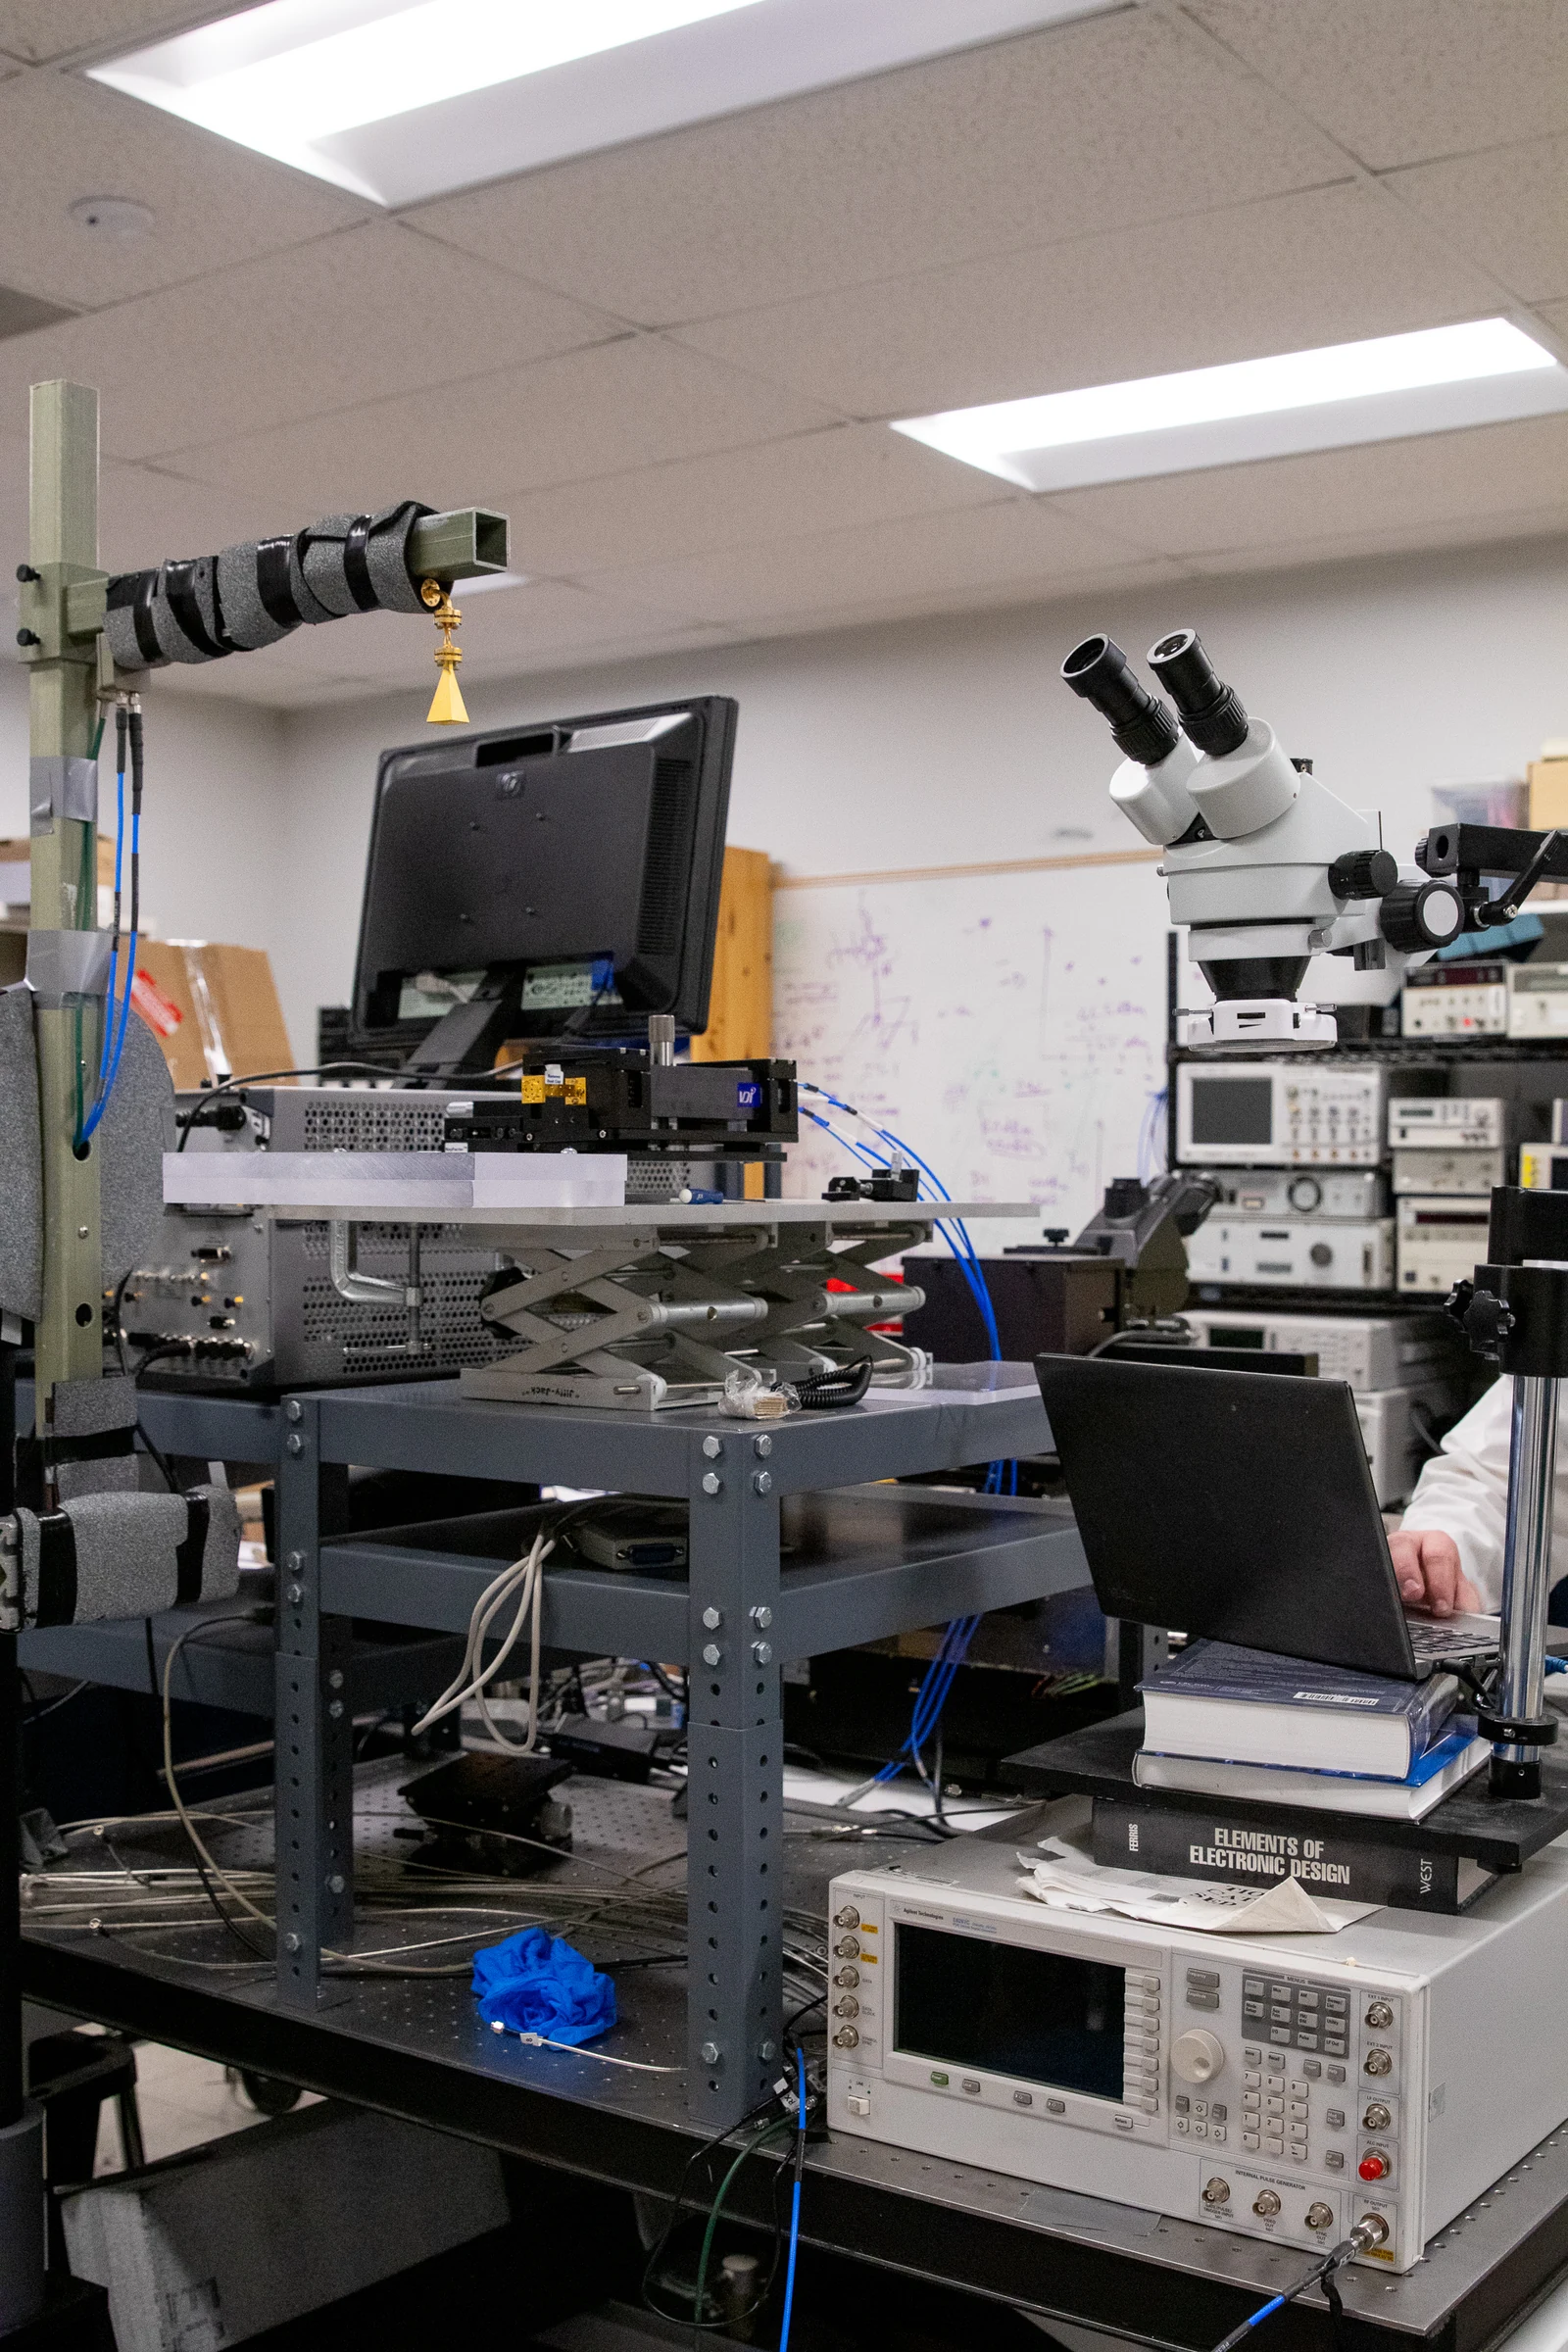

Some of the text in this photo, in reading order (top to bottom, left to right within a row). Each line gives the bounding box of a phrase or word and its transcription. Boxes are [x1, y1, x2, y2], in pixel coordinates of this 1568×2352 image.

[1129, 1823, 1139, 1852] FERRIS
[1214, 1827, 1325, 1860] ELEMENTS OF
[1190, 1844, 1350, 1886] ELECTRONIC DESIGN
[1420, 1858, 1433, 1894] WEST
[917, 1910, 944, 1921] Technologies
[1235, 2170, 1258, 2180] INTERNAL
[1276, 2180, 1305, 2190] GENERATOR
